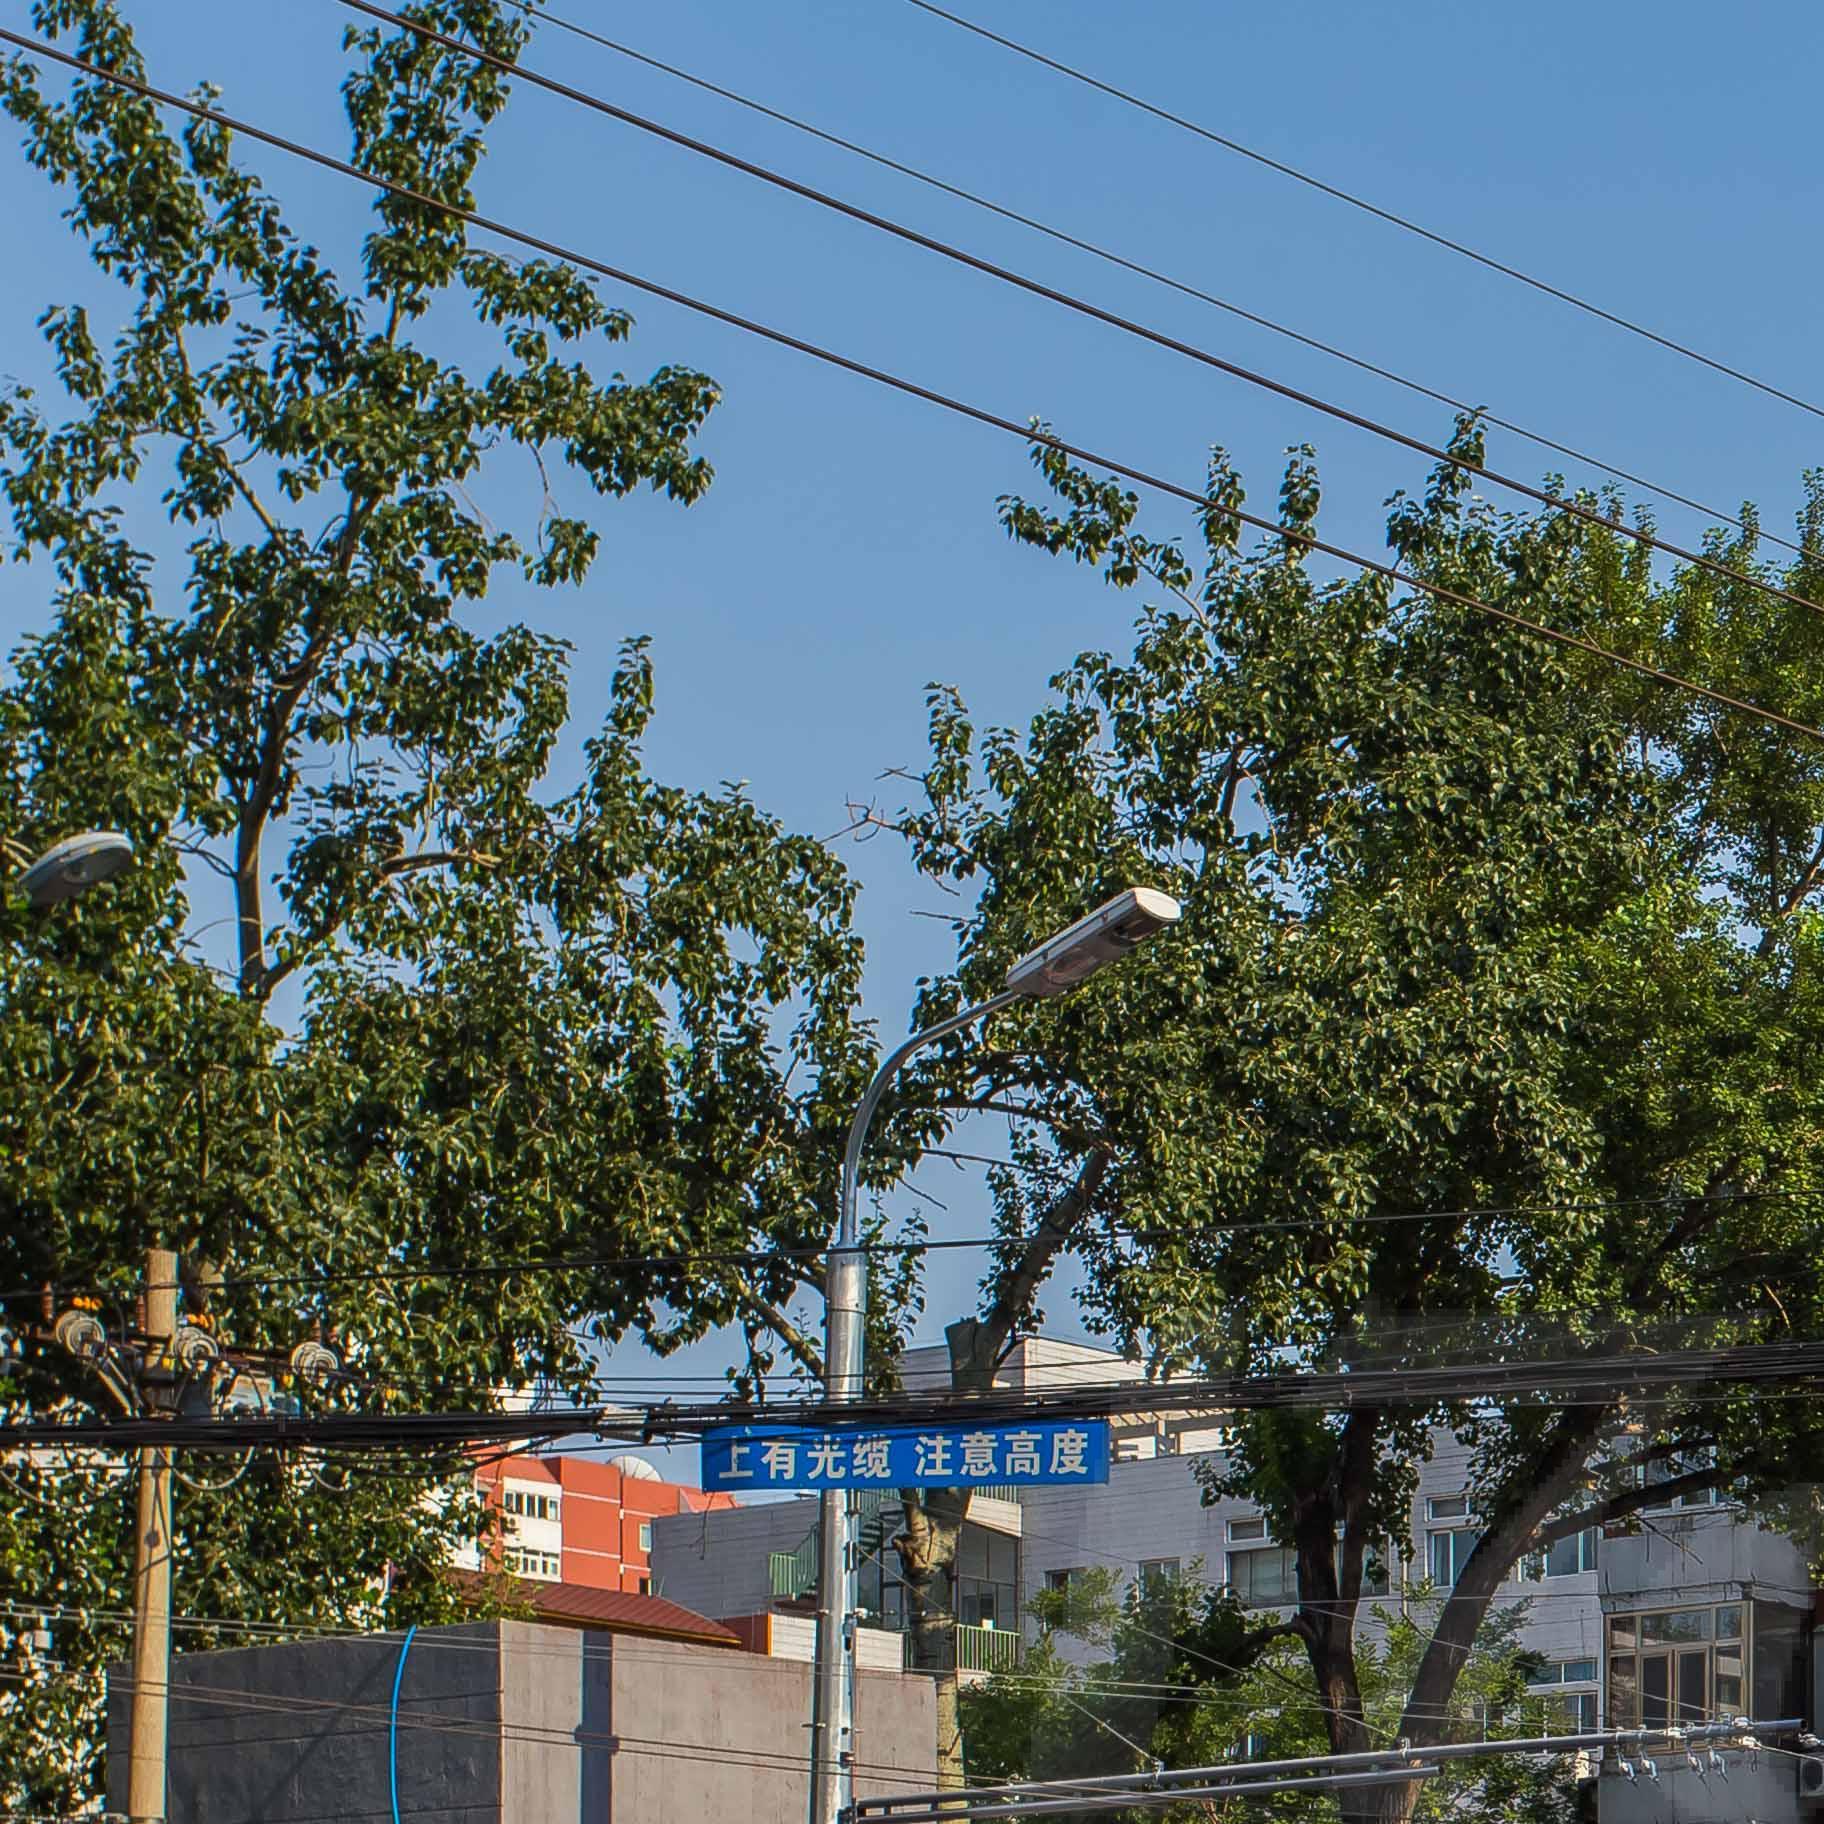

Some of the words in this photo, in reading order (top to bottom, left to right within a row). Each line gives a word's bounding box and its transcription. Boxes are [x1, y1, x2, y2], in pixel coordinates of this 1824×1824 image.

[719, 1432, 892, 1480] 上有光缆
[914, 1428, 1090, 1479] 注意高度
